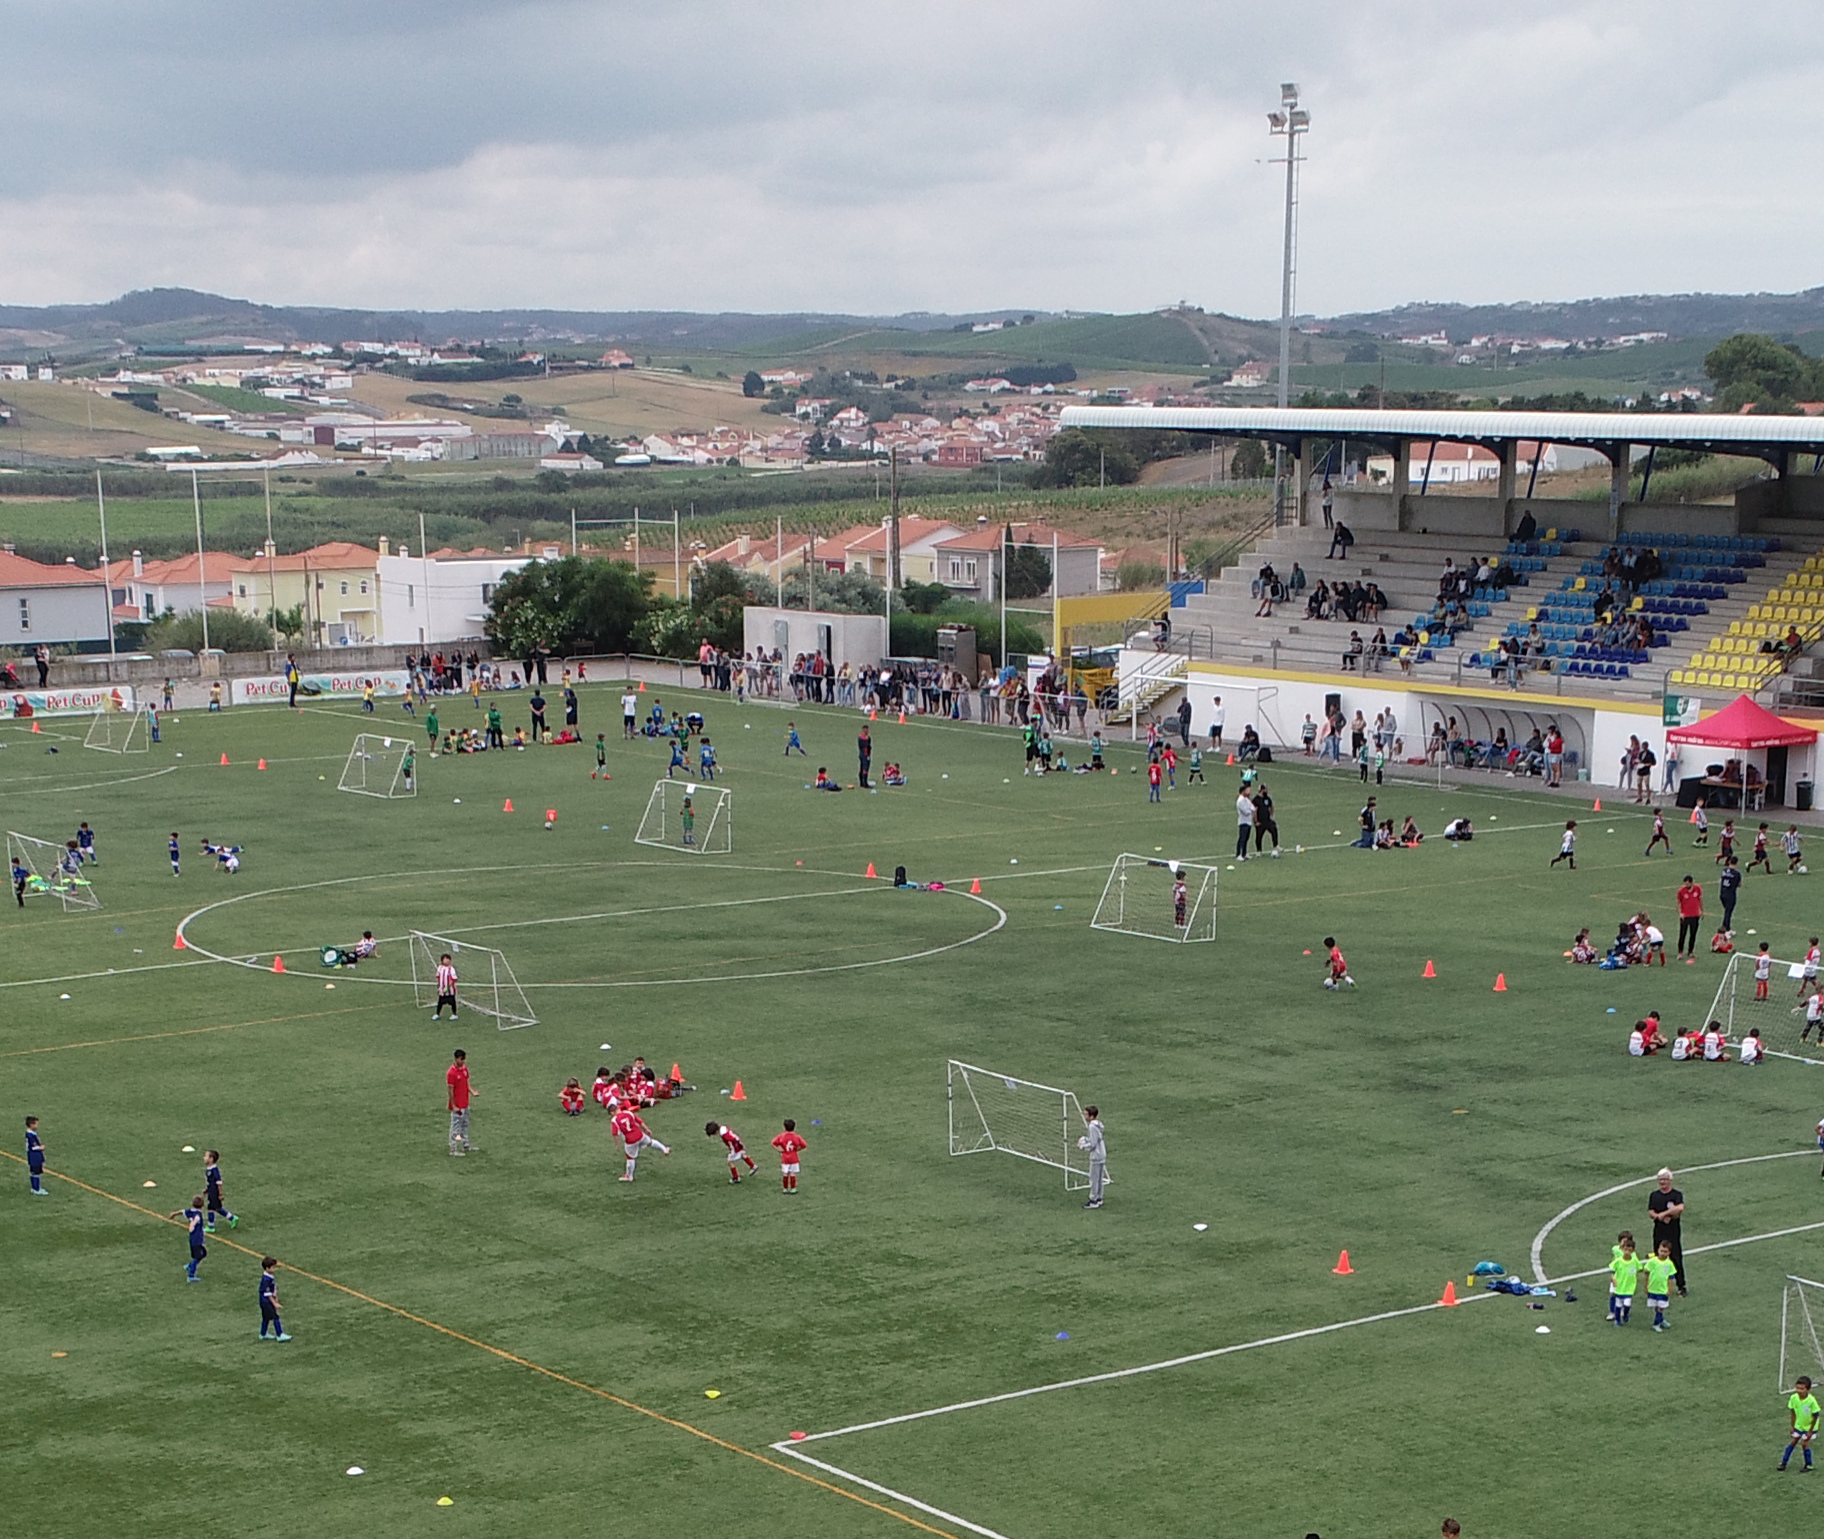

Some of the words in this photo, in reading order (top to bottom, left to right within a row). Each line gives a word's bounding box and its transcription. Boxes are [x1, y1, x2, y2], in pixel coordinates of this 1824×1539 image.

[246, 682, 267, 695] Pet
[332, 678, 353, 691] Pet
[355, 676, 382, 690] Cp
[46, 696, 69, 709] Pet
[72, 694, 101, 707] Cup
[620, 1117, 632, 1132] 7
